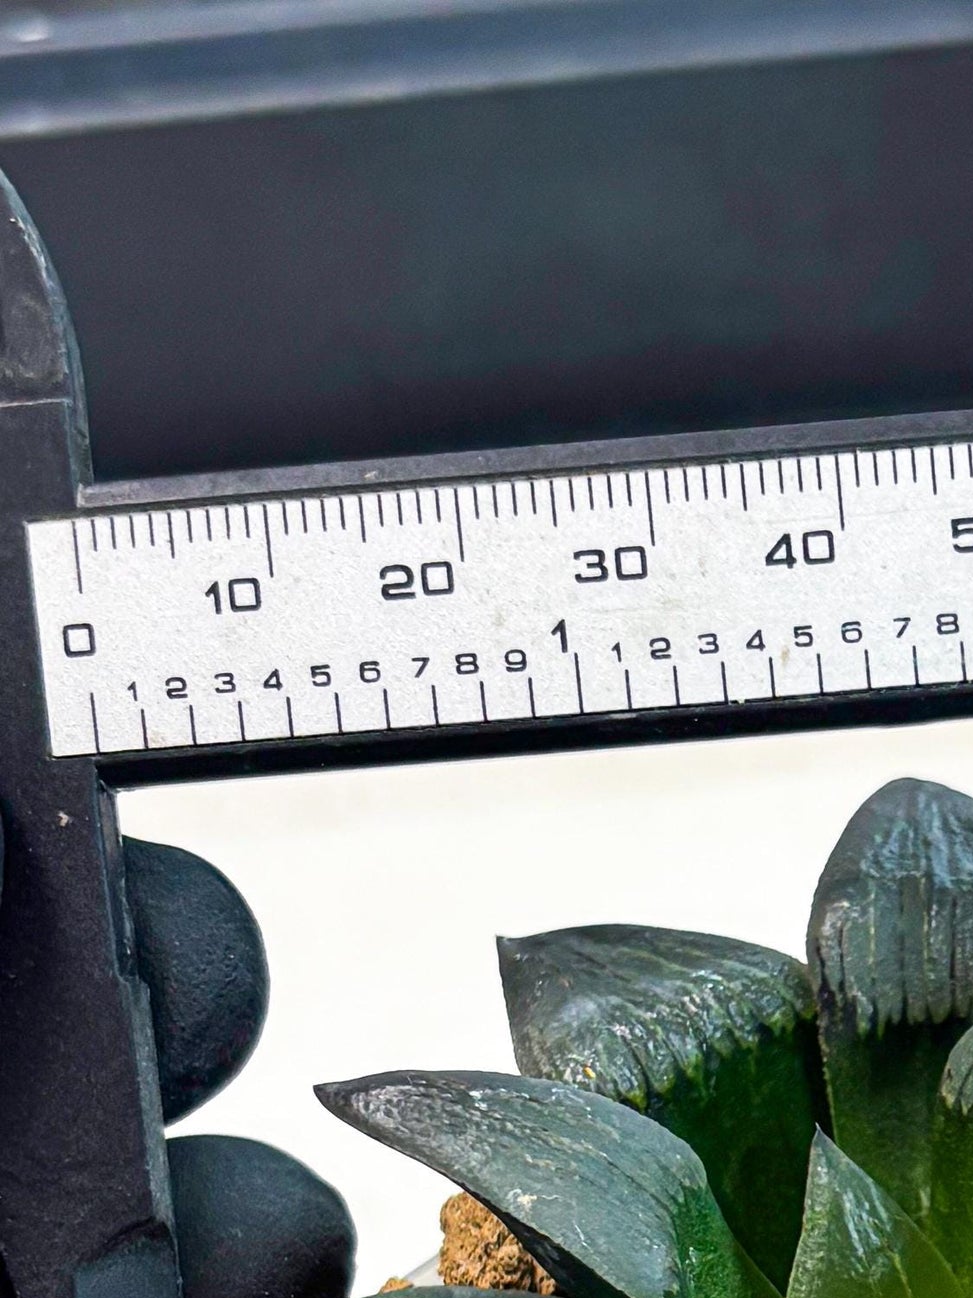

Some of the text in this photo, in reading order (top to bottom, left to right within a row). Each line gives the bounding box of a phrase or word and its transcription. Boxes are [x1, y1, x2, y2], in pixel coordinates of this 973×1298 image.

[63, 623, 96, 657] 0
[205, 578, 261, 614] 10
[380, 561, 454, 600] 20
[573, 546, 648, 583] 30
[765, 530, 835, 569] 40
[127, 681, 139, 702] 1
[165, 676, 188, 700] 2
[214, 672, 236, 694] 3
[263, 668, 283, 691] 4
[310, 664, 331, 687] 5
[359, 660, 381, 684] 6
[411, 657, 430, 678] 7
[455, 652, 480, 675] 8
[504, 649, 527, 673] 9
[551, 619, 568, 653] 1
[611, 642, 622, 663] 1
[649, 637, 671, 660] 2
[698, 633, 719, 655] 3
[745, 629, 766, 651] 4
[793, 625, 814, 647] 5
[841, 621, 864, 644] 6
[893, 618, 912, 639] 7
[936, 613, 960, 635] 8
